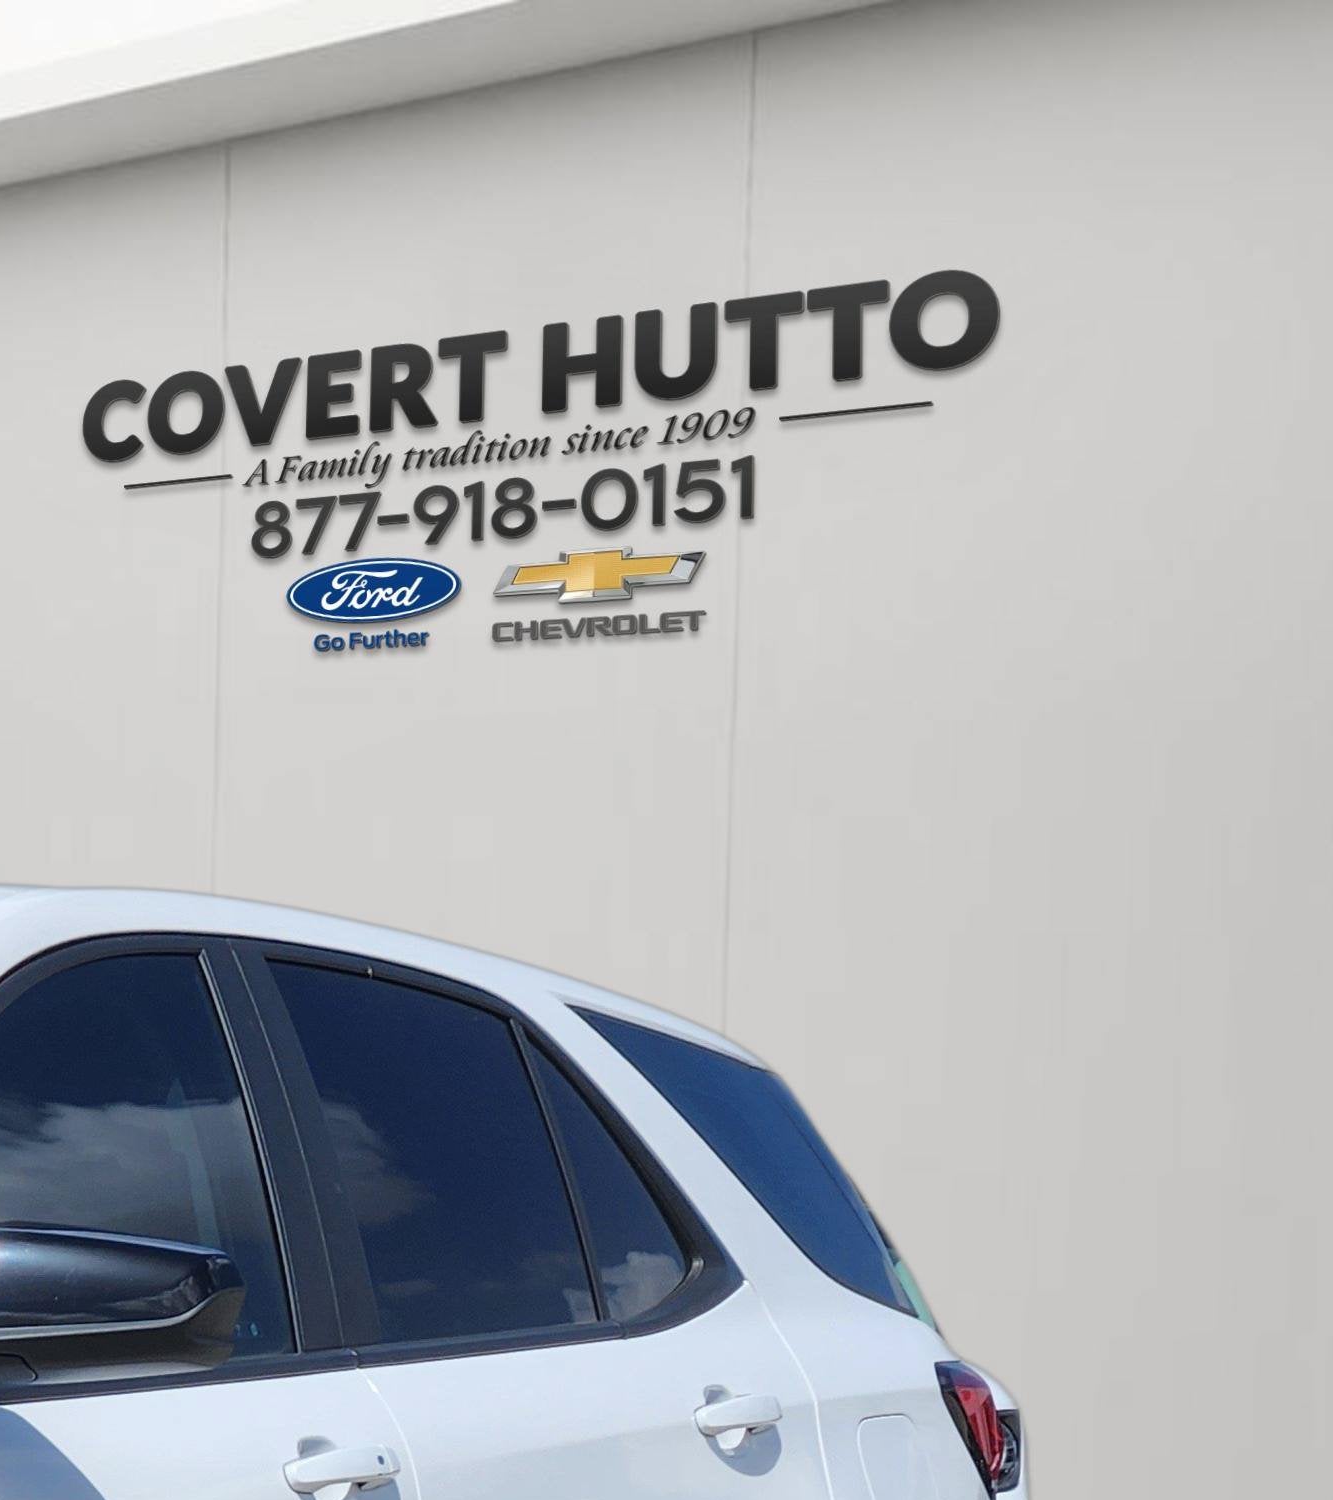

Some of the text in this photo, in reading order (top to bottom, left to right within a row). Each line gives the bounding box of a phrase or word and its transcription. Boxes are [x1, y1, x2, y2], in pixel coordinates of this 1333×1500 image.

[81, 269, 1002, 464] COVERT HUTTO
[242, 406, 756, 488] A Family tradition since 1909
[250, 454, 755, 559] 877-918-0151
[321, 569, 422, 610] Ford
[312, 629, 430, 653] Go Further
[491, 609, 707, 643] CHEVROLET
